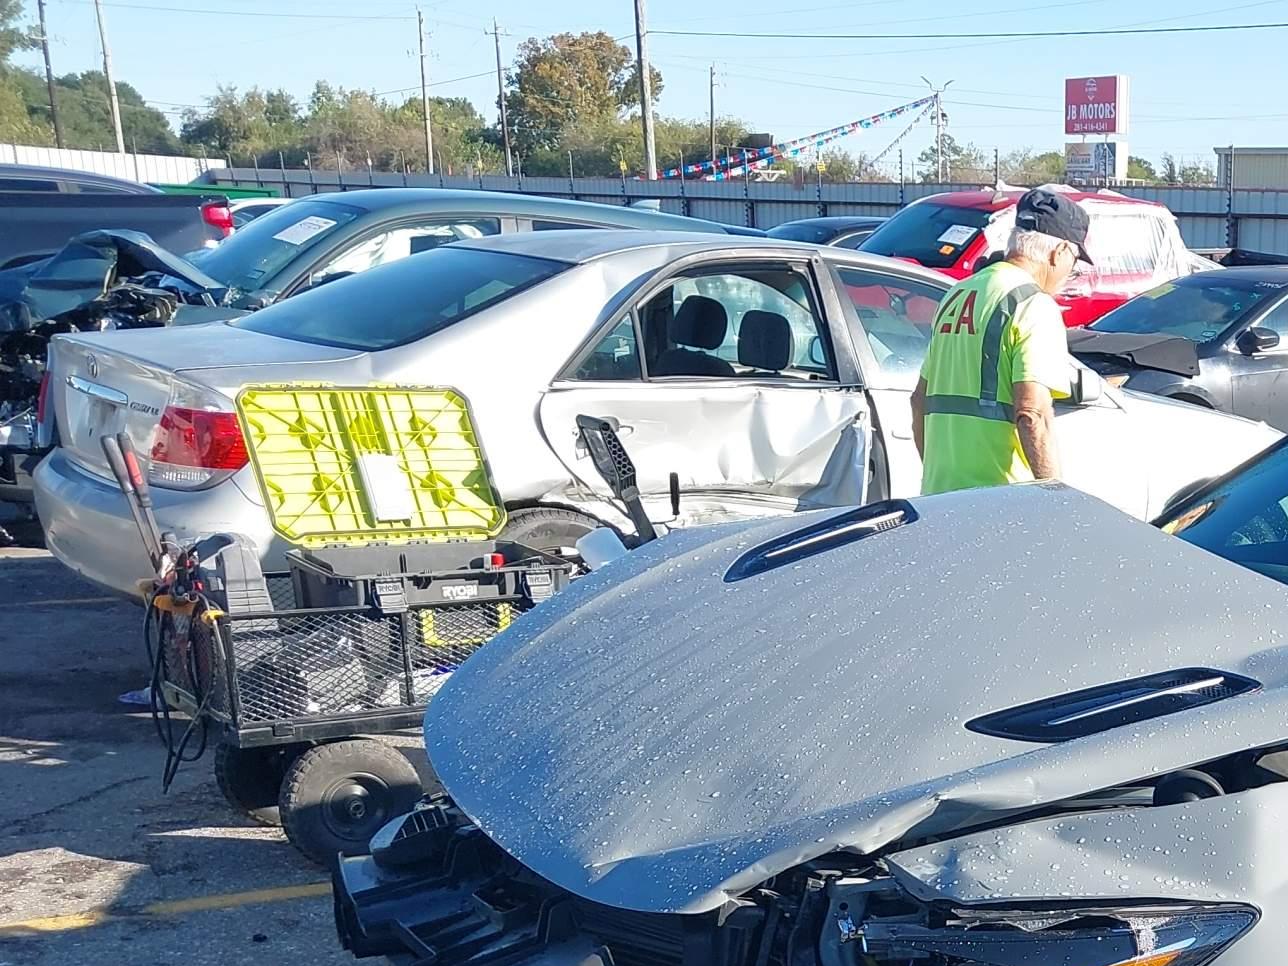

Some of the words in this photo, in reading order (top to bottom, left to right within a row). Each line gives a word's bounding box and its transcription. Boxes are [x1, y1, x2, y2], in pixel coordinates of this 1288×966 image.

[1067, 104, 1077, 120] JB
[1079, 102, 1116, 120] MOTORS
[378, 584, 401, 593] RYOBI
[441, 584, 478, 597] RYOBI
